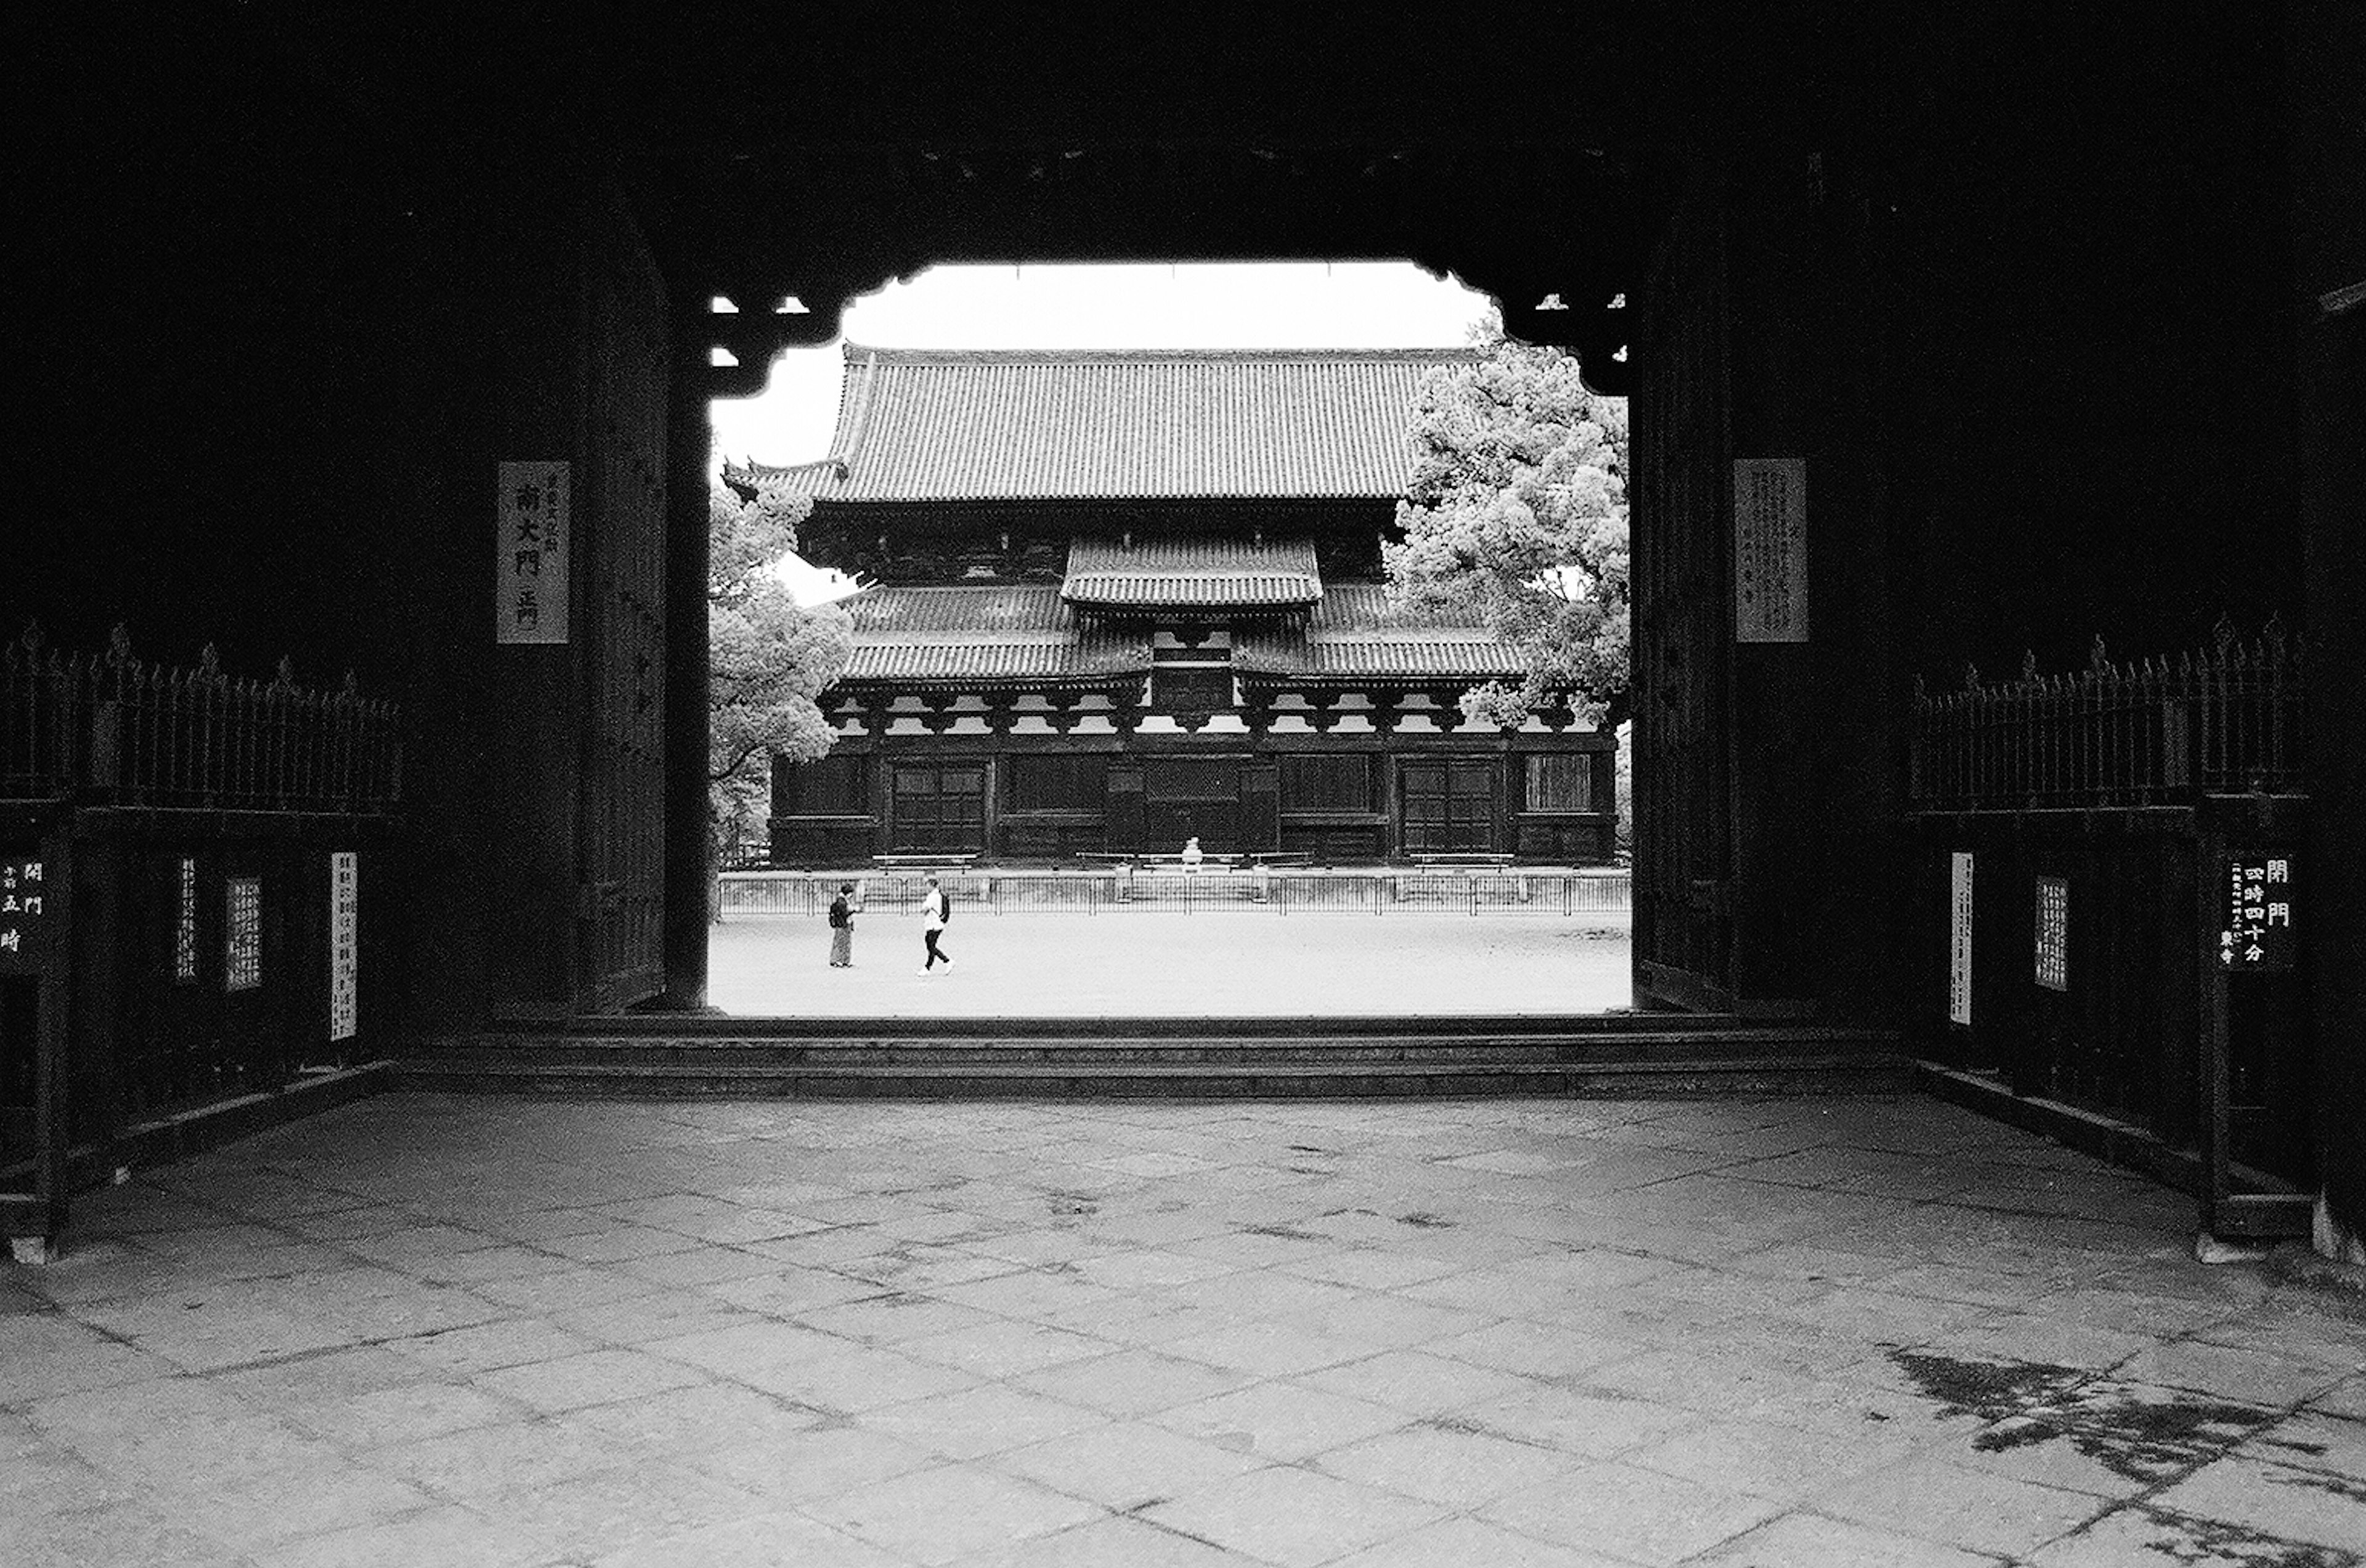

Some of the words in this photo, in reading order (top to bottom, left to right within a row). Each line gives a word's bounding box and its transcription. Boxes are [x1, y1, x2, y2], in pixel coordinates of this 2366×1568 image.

[1, 866, 21, 952] 午前五時
[25, 863, 43, 915] 開門
[2244, 867, 2265, 961] 四時四十分
[2267, 859, 2289, 927] 閉門
[2220, 930, 2235, 964] 東寺
